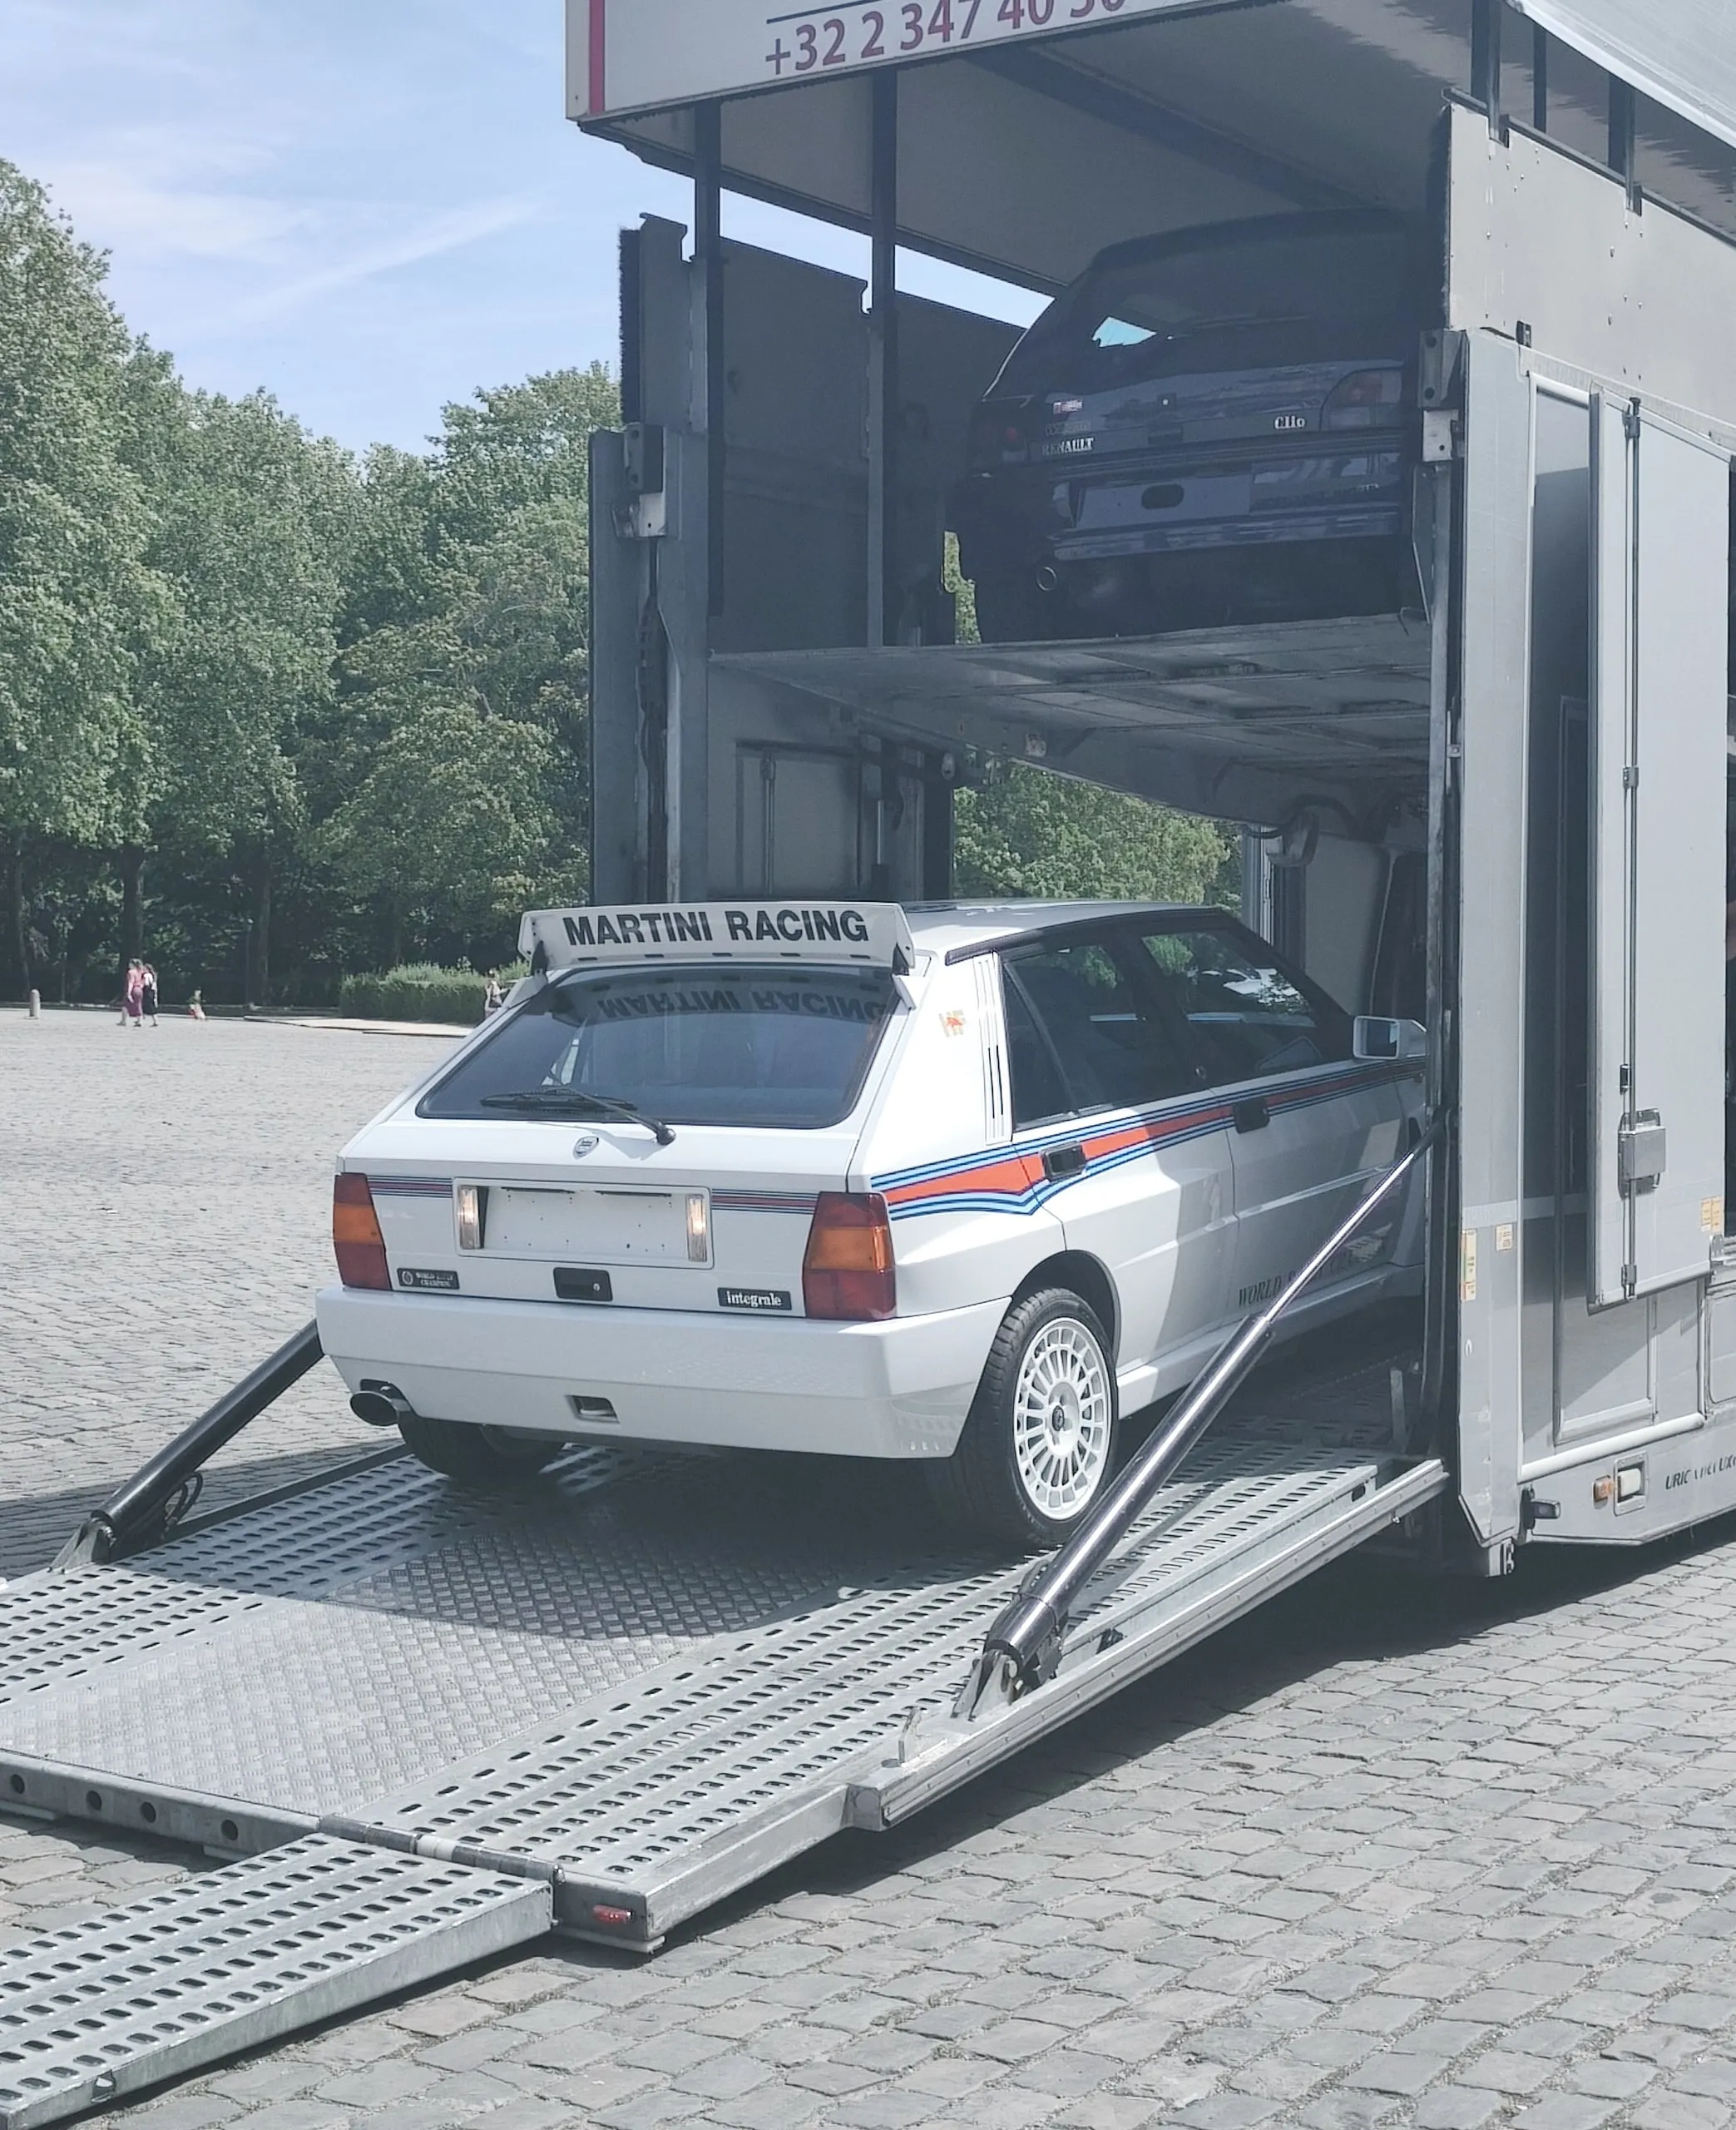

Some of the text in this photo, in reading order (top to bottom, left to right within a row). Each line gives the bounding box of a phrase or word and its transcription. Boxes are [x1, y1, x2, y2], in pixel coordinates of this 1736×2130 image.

[765, 18, 847, 75] +32
[860, 11, 885, 59] 2
[899, 0, 982, 51] 347
[1274, 415, 1306, 430] Clio
[1042, 437, 1095, 456] RENAULT
[562, 909, 868, 946] MARTINI RACING
[726, 1290, 782, 1308] integrale
[1239, 1276, 1282, 1306] WORLD
